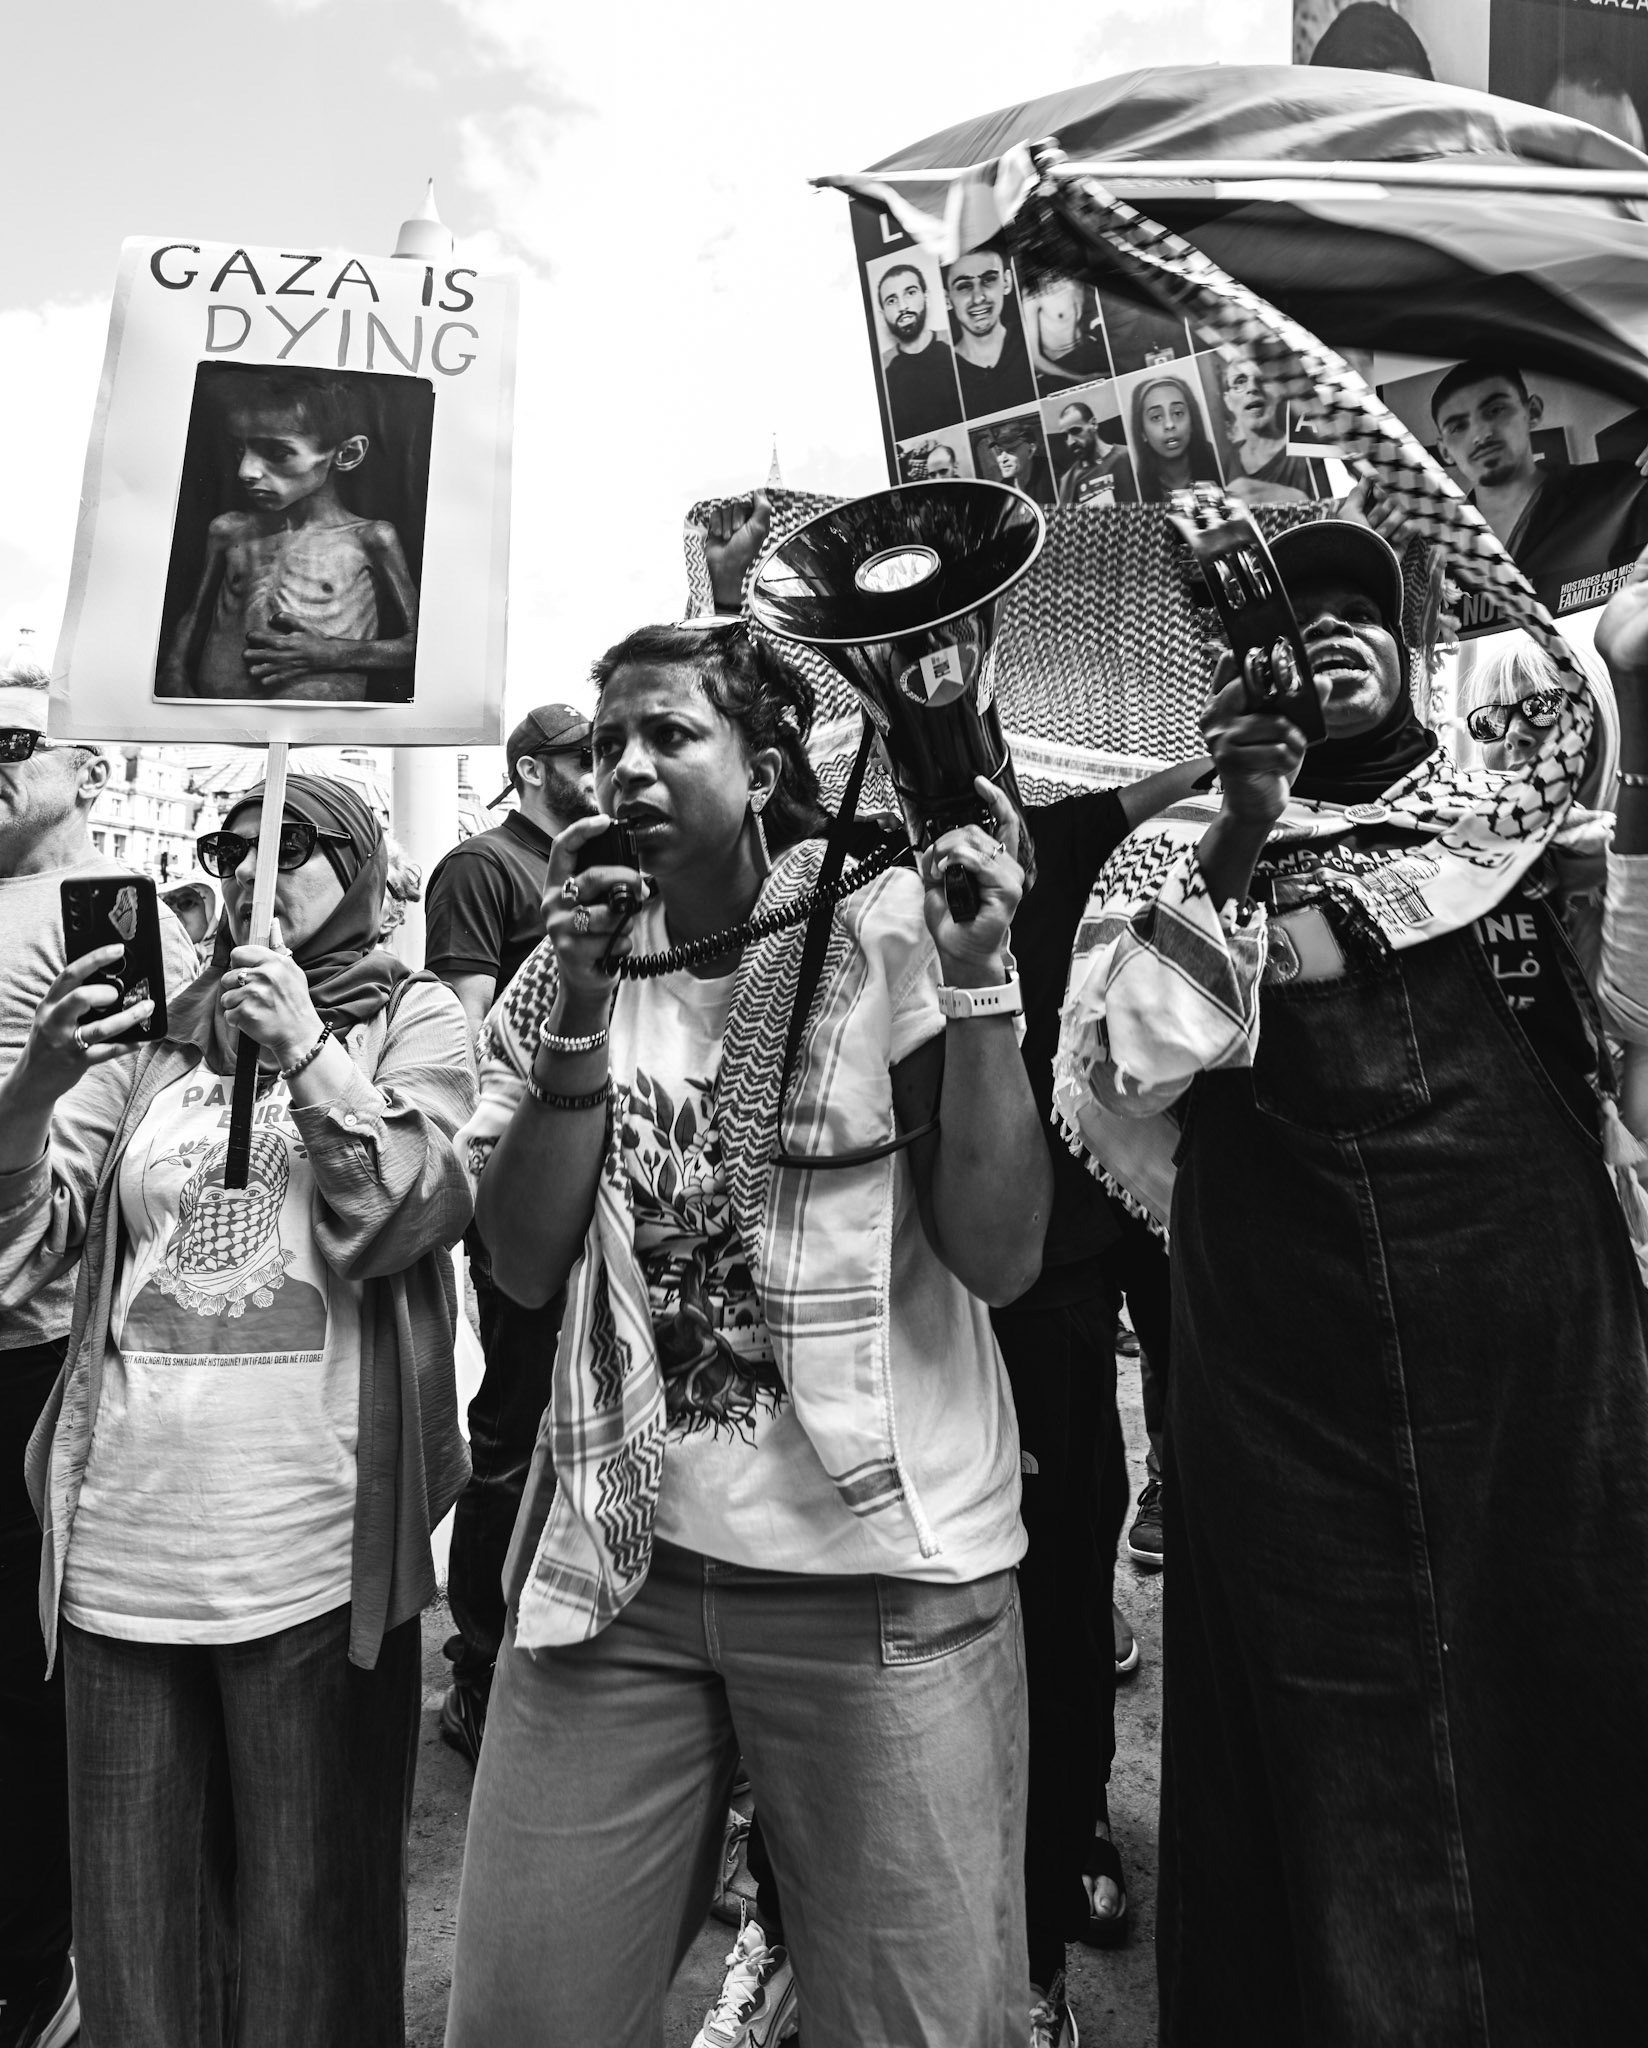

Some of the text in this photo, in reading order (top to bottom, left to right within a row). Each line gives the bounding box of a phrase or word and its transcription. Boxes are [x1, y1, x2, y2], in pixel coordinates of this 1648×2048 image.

[150, 244, 478, 312] GAZA IS
[205, 304, 479, 376] DYING
[1558, 581, 1610, 610] FAMILIES
[1560, 574, 1601, 595] HOSTAGES
[1601, 568, 1618, 583] AND
[241, 1355, 273, 1366] INTIFADA!
[274, 1355, 290, 1365] DERI
[290, 1353, 299, 1364] NË
[299, 1353, 324, 1364] FITORE!
